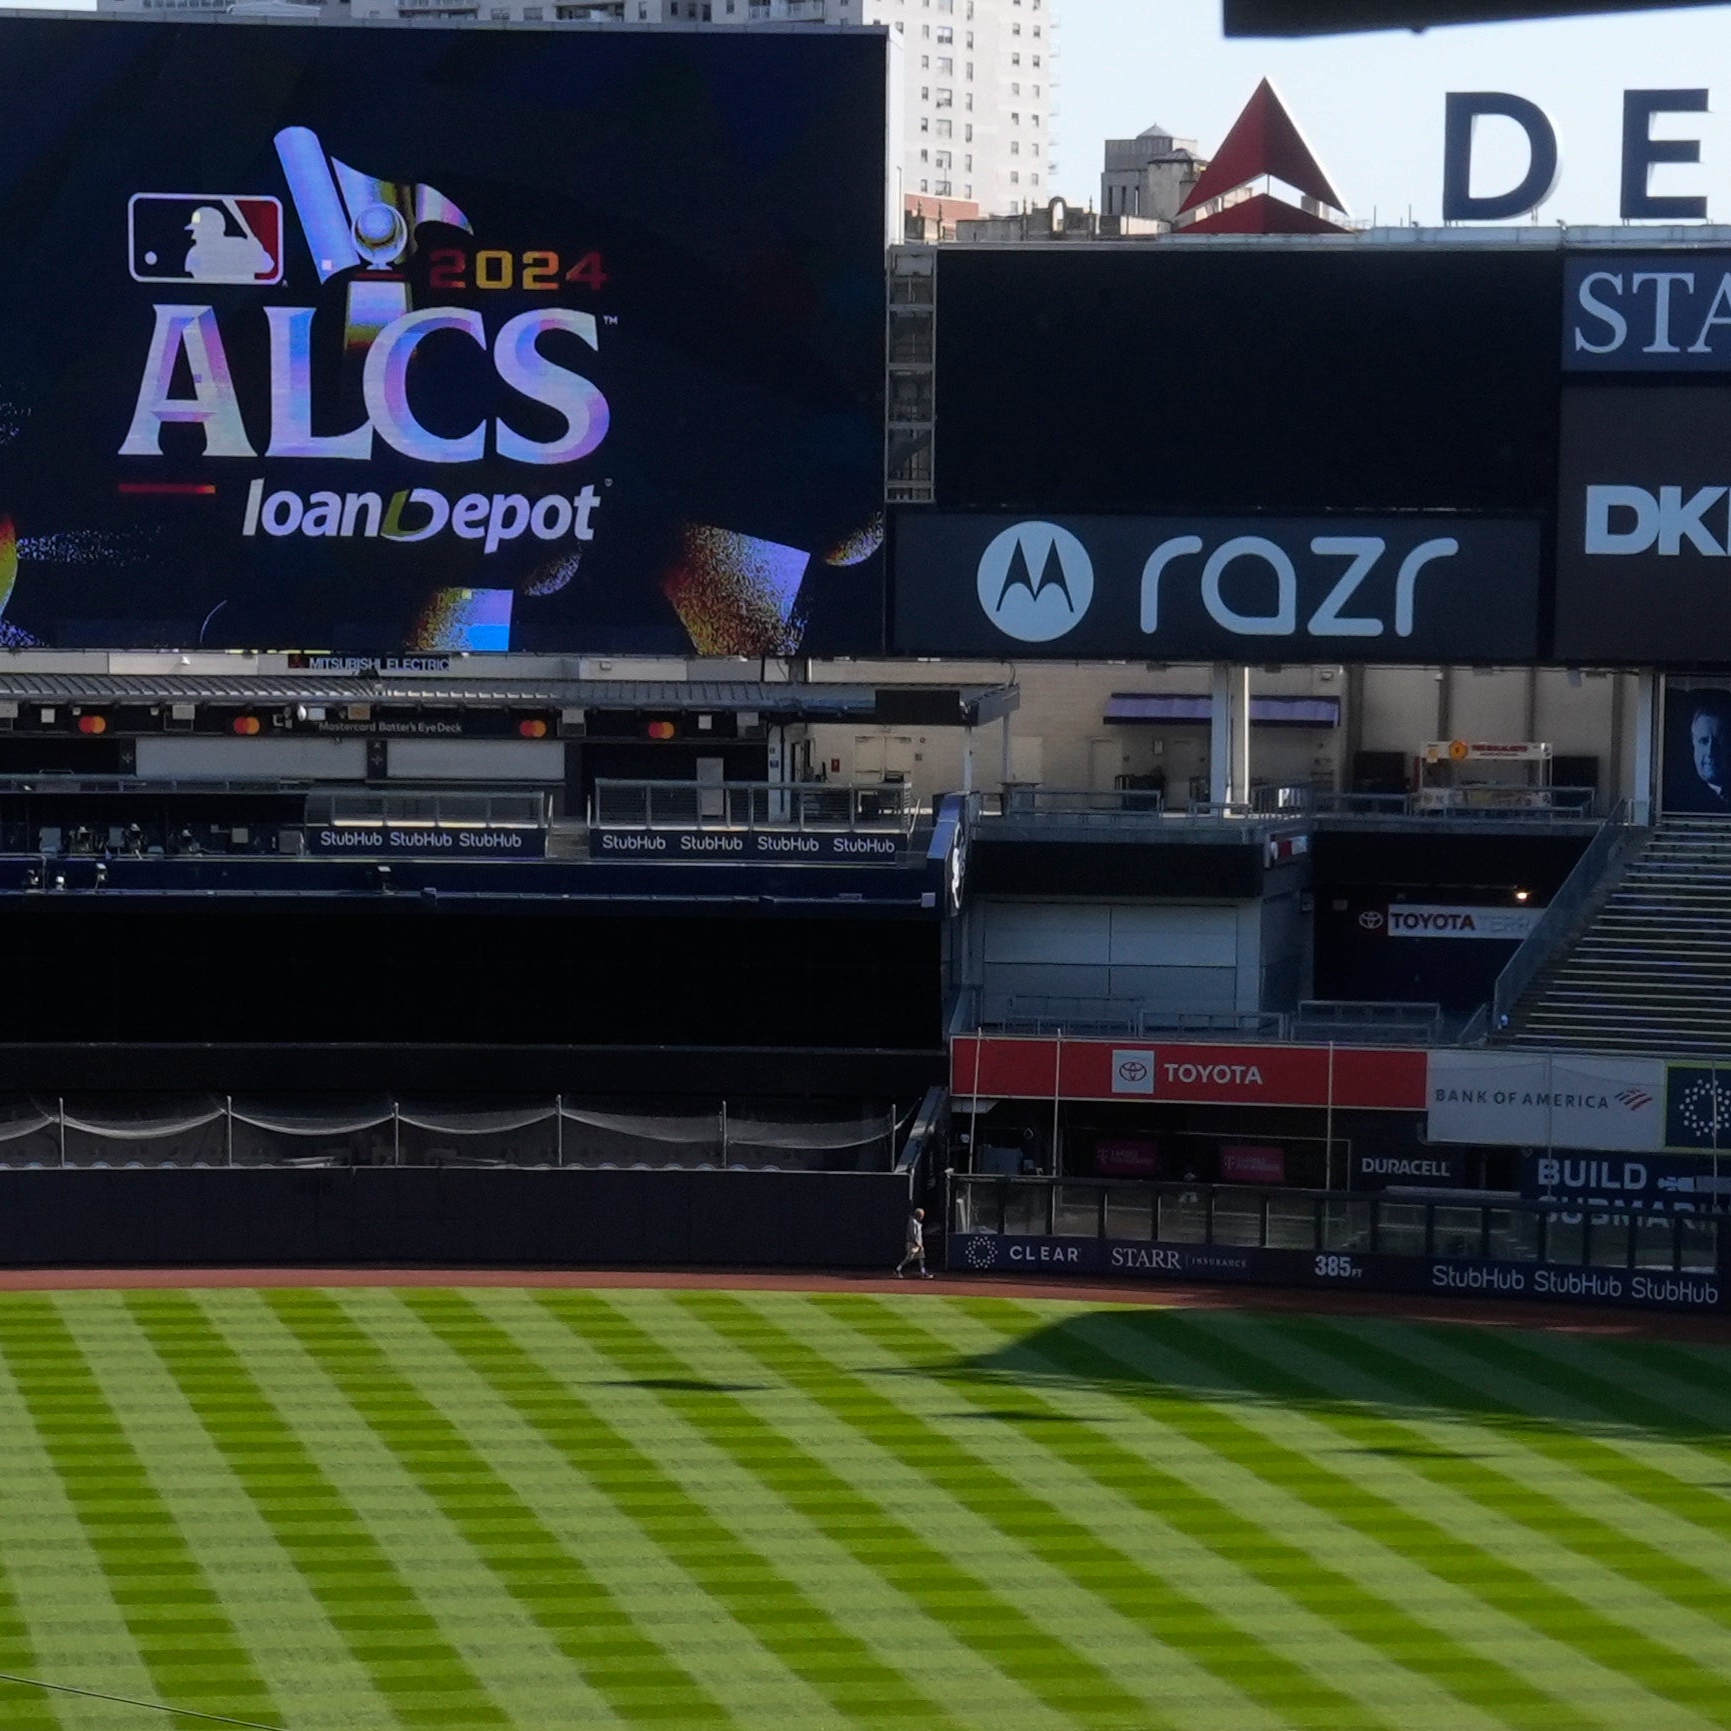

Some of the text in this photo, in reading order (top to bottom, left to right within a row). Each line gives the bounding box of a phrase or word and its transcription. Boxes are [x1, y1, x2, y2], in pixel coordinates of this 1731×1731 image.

[430, 249, 609, 290] 2024
[118, 304, 611, 465] ALCS
[242, 478, 602, 555] loanDepot
[1140, 536, 1459, 638] razr
[309, 657, 450, 671] MITSUBISHI ELECTRIC
[319, 720, 376, 734] Mastercard
[320, 831, 522, 849] StubHub StubHub StubHub
[602, 834, 895, 853] StubHub StubHub StubHub StubHub
[1391, 912, 1476, 931] TOYOTA
[1164, 1063, 1263, 1086] TOYOTA
[1436, 1089, 1609, 1109] BANK OF AMERICA
[1362, 1157, 1451, 1178] DURACELL
[1537, 1158, 1648, 1190] BUILD
[1009, 1245, 1079, 1264] CLEAR
[1110, 1246, 1247, 1271] STARR INSURANCE
[1432, 1264, 1718, 1304] StubHub StubHub StubHub
